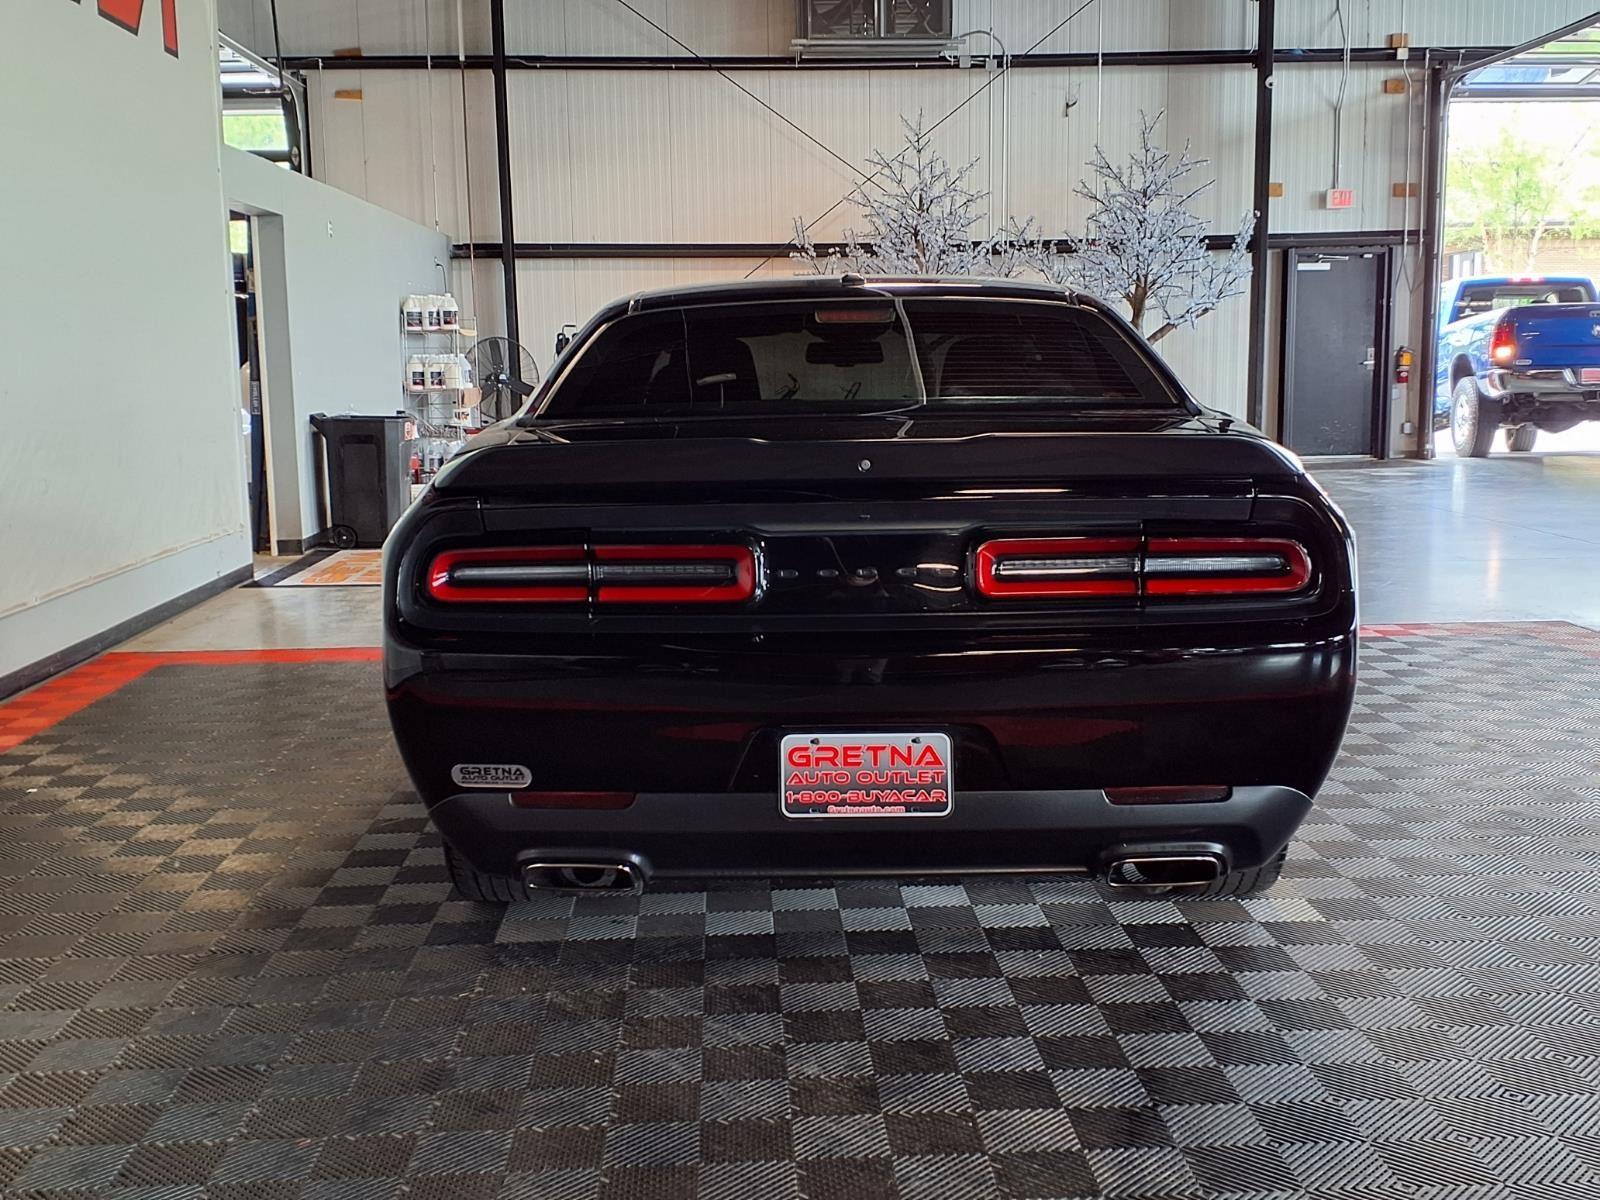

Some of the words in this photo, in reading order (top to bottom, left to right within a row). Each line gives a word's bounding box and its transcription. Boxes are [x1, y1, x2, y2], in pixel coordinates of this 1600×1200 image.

[786, 744, 945, 768] GRETNA
[460, 767, 525, 776] GRETNA
[786, 771, 850, 785] AUTO
[856, 770, 947, 785] OUTLET
[786, 789, 947, 804] 1-800-BUYACAR
